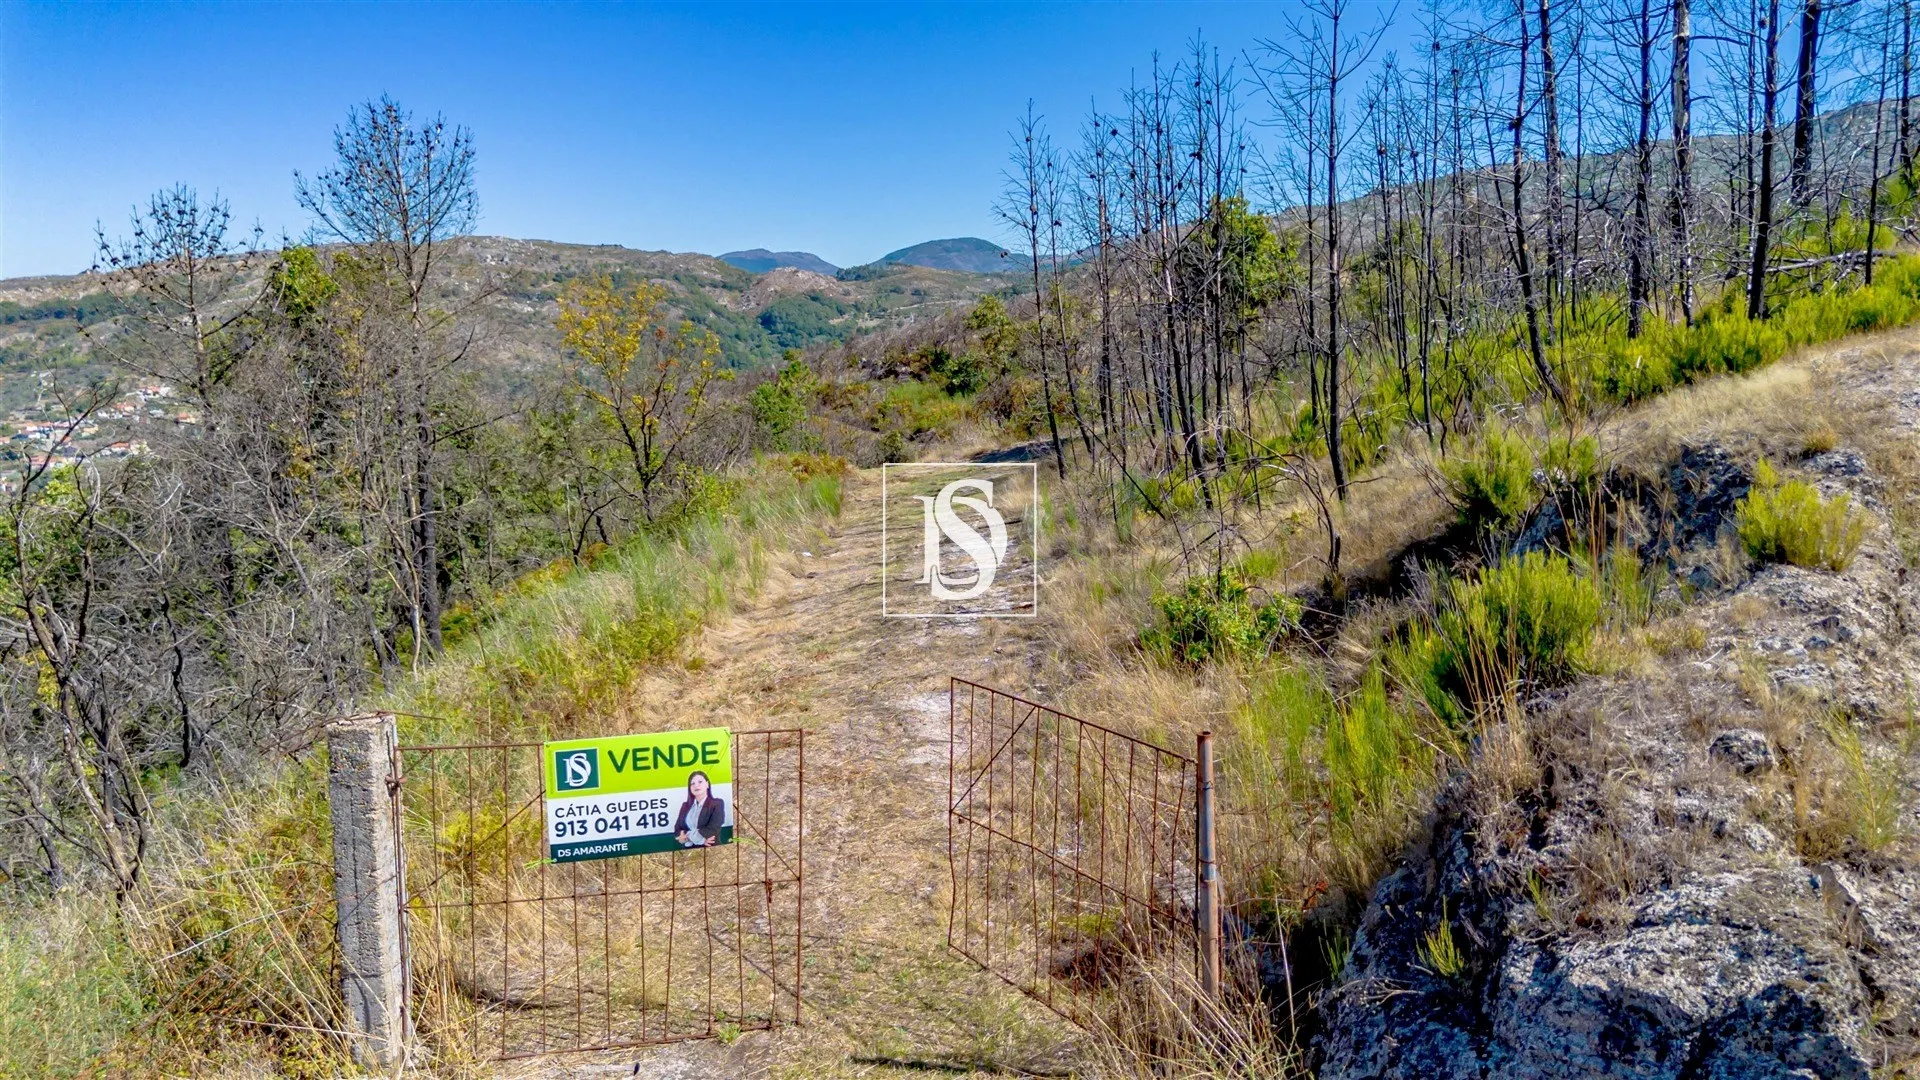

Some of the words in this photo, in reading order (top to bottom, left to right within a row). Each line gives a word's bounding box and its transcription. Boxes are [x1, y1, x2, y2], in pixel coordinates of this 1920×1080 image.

[607, 740, 720, 773] VENDE
[555, 803, 601, 818] CÁTIA
[606, 798, 668, 813] GUEDES
[554, 820, 588, 838] 913
[595, 815, 630, 834] 041
[636, 811, 670, 829] 418
[557, 848, 571, 857] DS
[573, 842, 628, 856] AMARANTE
